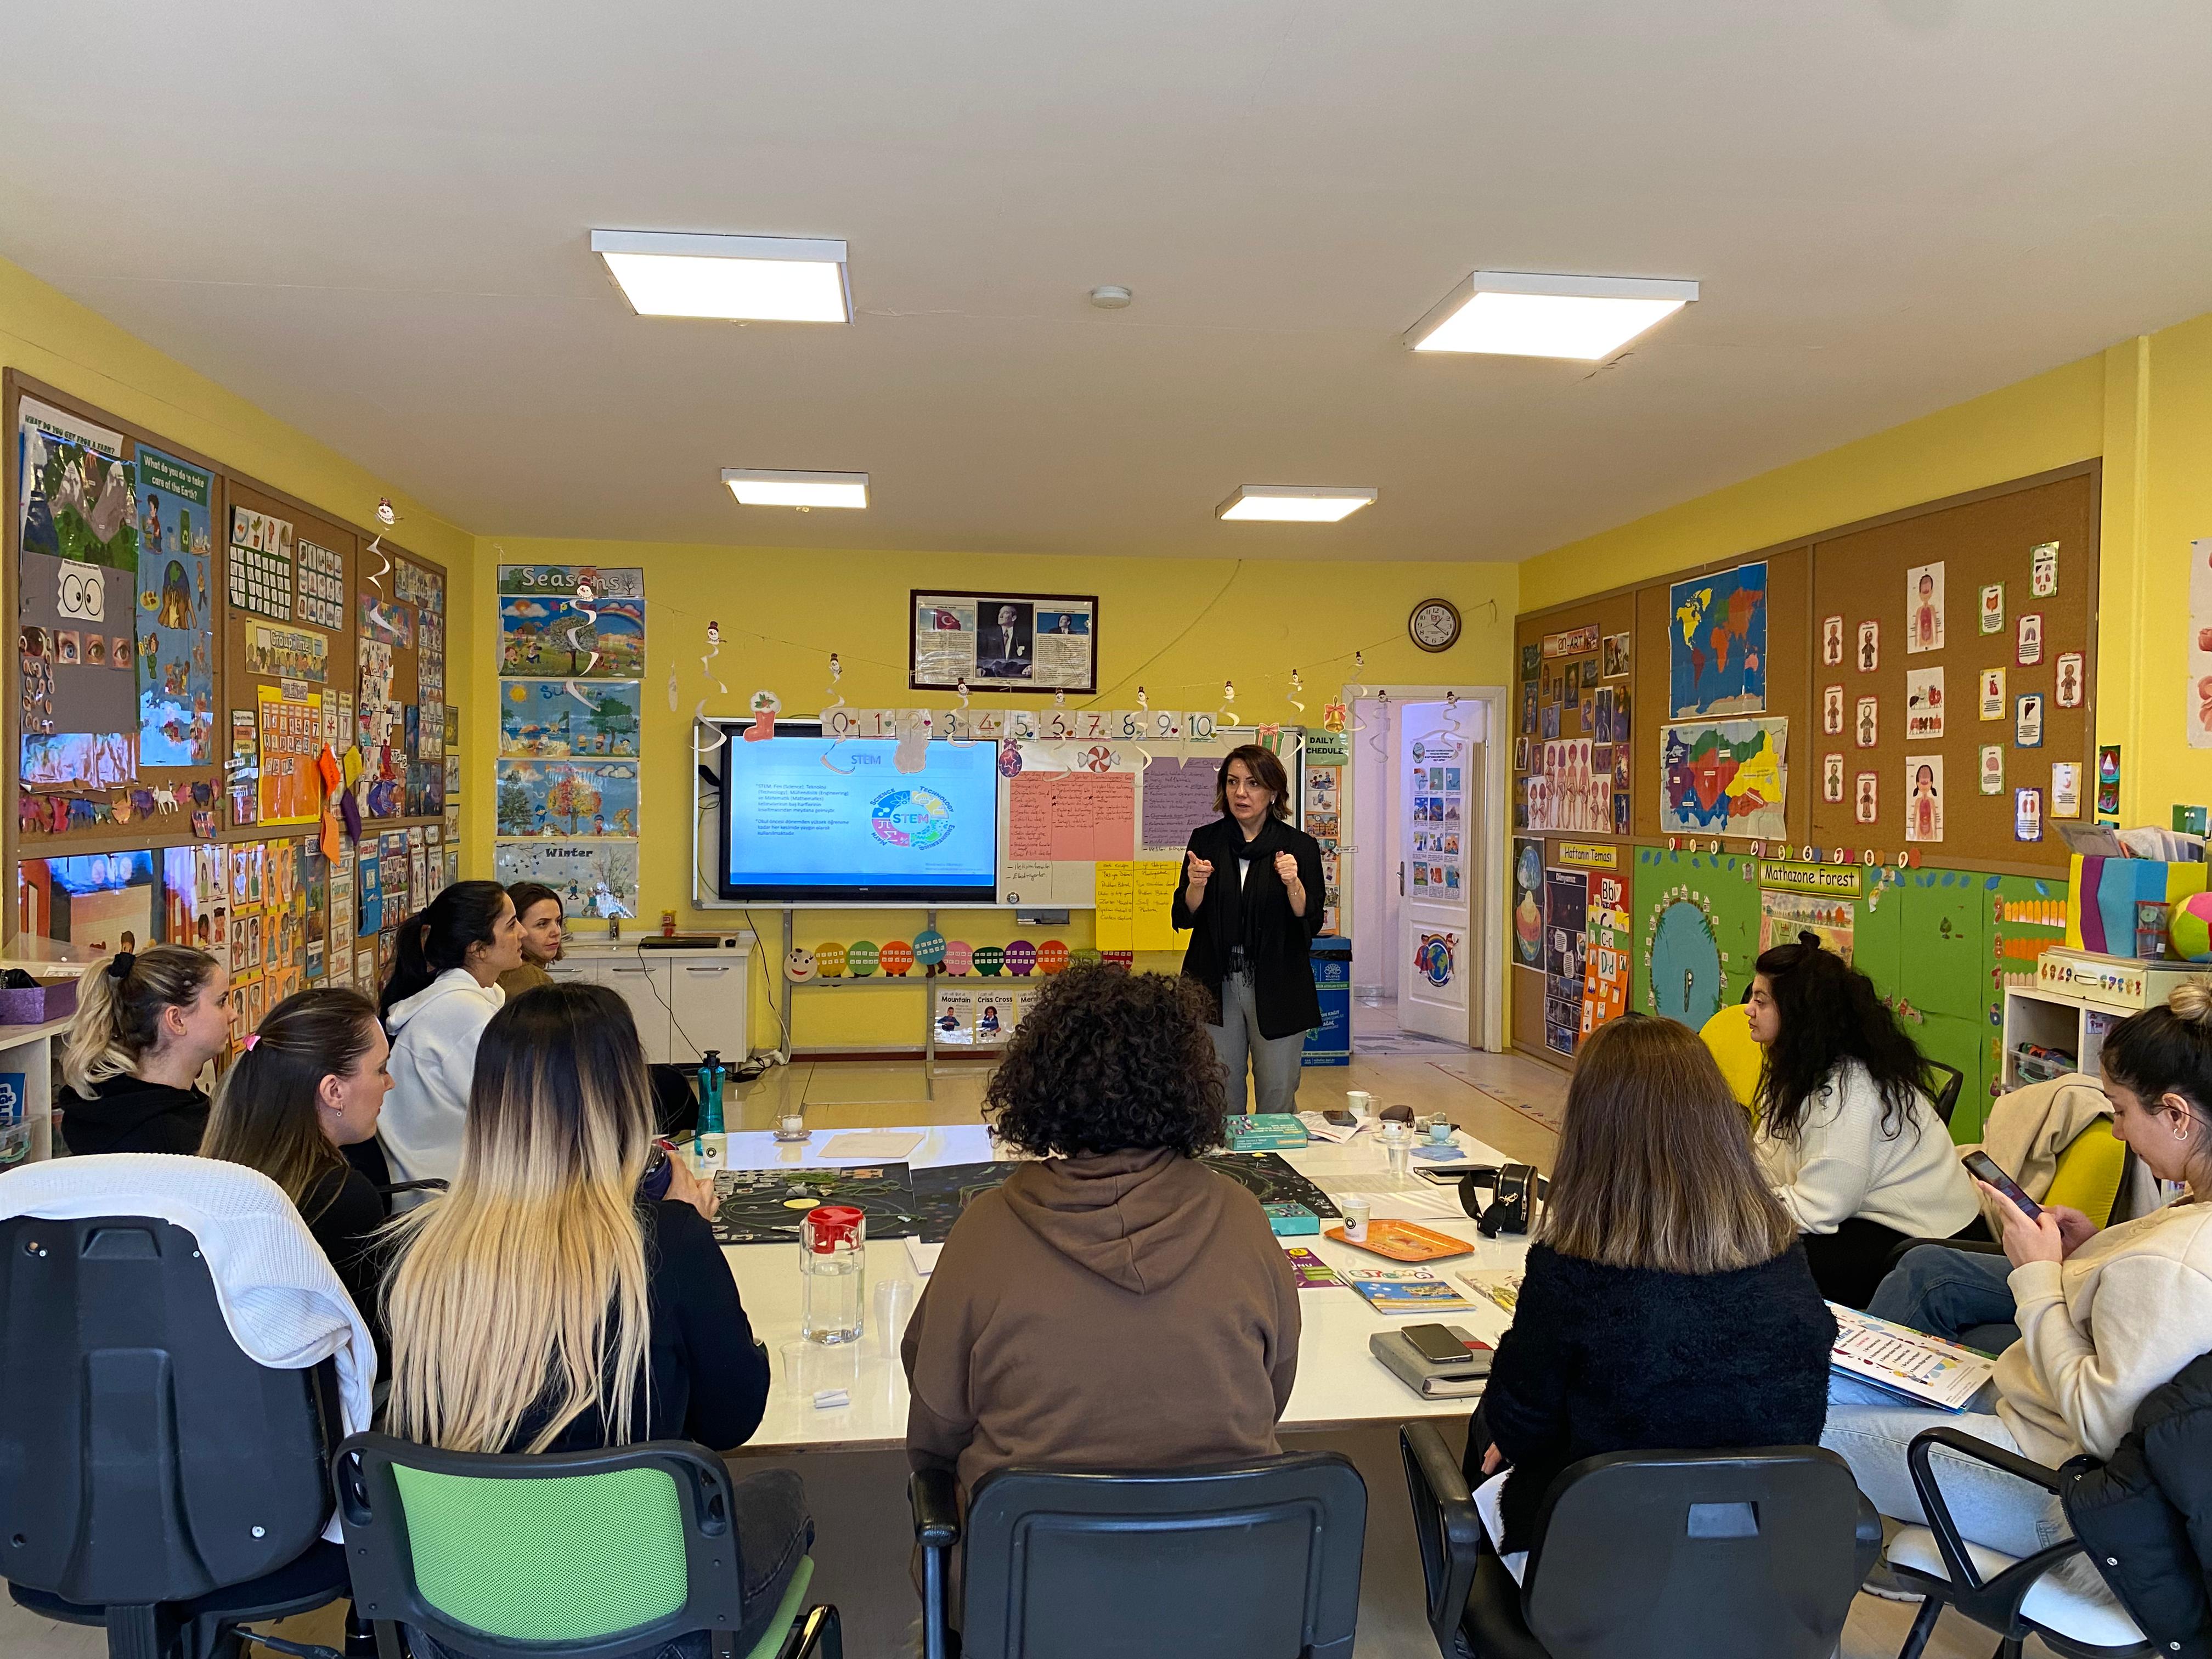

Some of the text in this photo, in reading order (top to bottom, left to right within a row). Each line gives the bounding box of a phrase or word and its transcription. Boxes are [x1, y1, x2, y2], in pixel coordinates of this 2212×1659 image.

[25, 415, 42, 427] WHAT
[43, 422, 50, 431] DO
[53, 426, 63, 436] YOU
[65, 431, 76, 441] GET
[144, 455, 160, 470] What
[161, 462, 168, 473] do
[168, 467, 178, 477] you
[179, 470, 185, 481] do
[192, 476, 204, 488] take
[152, 477, 197, 500] care of the Earth?
[270, 629, 292, 654] Group
[296, 720, 300, 732] 5
[305, 721, 308, 732] 6
[313, 724, 318, 736] 7
[832, 712, 848, 733] 0
[874, 713, 881, 734] 1
[944, 714, 956, 734] 3
[979, 713, 995, 732] 4
[1014, 714, 1028, 736] 5
[1087, 715, 1100, 736] 7
[1124, 715, 1135, 735] 8
[1157, 714, 1171, 736] 9
[1188, 714, 1212, 737] 10
[851, 755, 881, 765] STEM
[870, 788, 896, 806] SCIENCE
[919, 786, 955, 813] TECHNOLOGY
[893, 814, 929, 823] STEM
[871, 832, 887, 847] MATH
[919, 824, 955, 851] ENGINEERING
[546, 848, 593, 858] Winter
[1565, 847, 1611, 862] Haftanın Teması
[1805, 847, 1810, 859] 6
[1835, 849, 1842, 862] 7
[1866, 852, 1872, 864] 8
[1900, 853, 1905, 867] 9
[1765, 865, 1854, 887] Mathazone Forest
[1602, 882, 1614, 901] Bb
[1601, 929, 1612, 946] C-c
